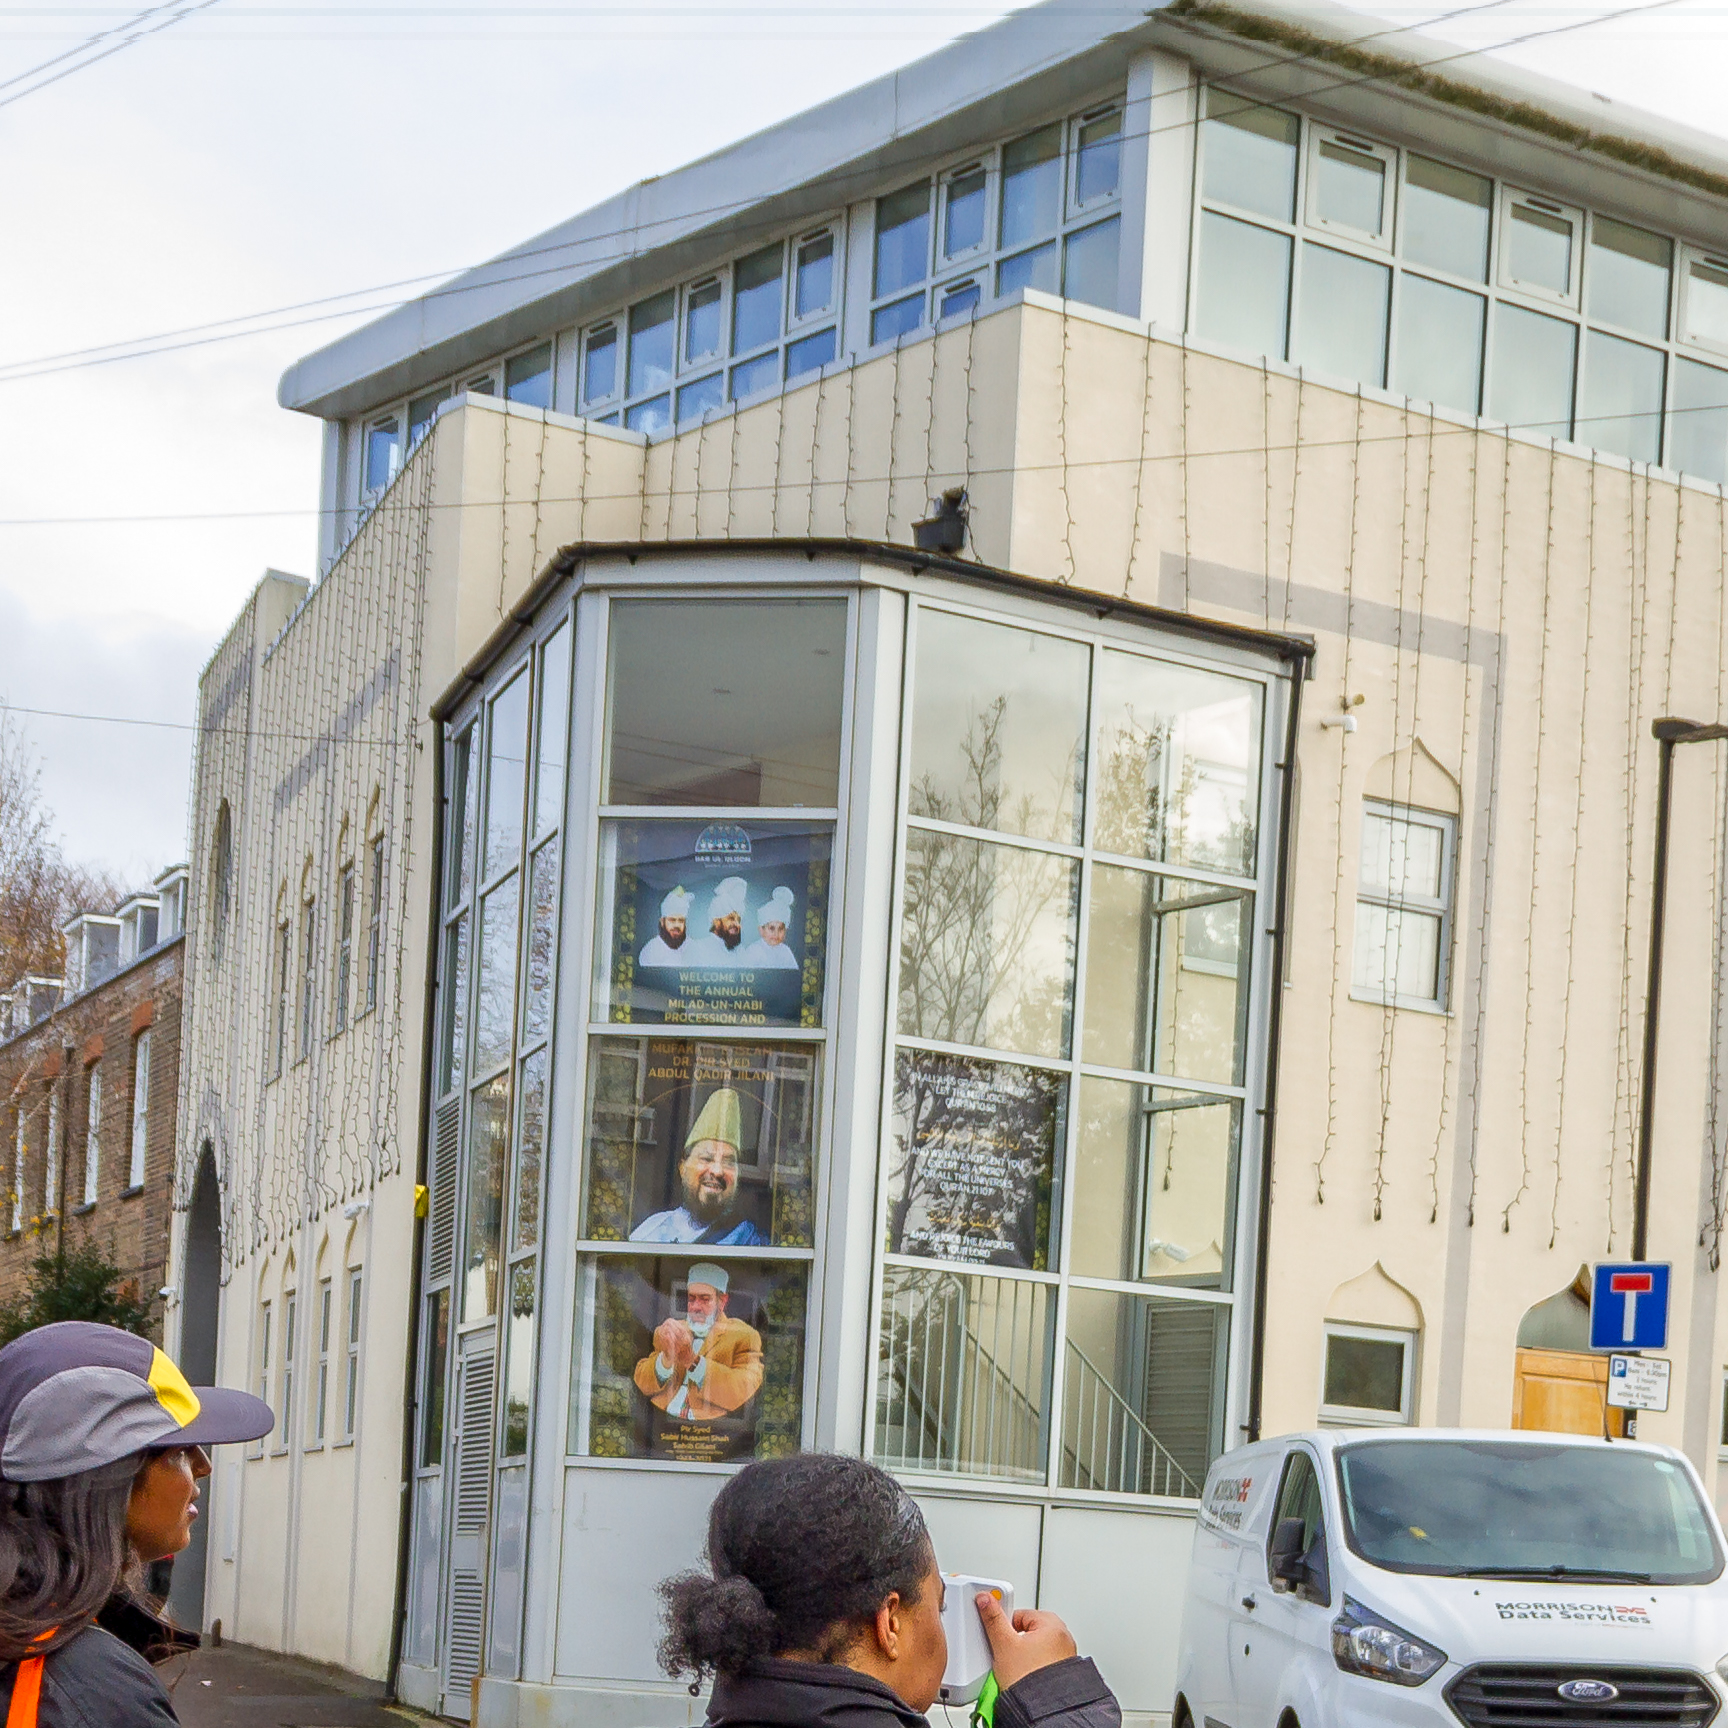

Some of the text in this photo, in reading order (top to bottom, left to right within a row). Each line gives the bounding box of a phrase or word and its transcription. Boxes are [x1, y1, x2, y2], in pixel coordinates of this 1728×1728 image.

[679, 971, 755, 983] WELCOME TO
[679, 985, 754, 997] THE ANNUAL
[668, 999, 763, 1011] MILAD-UN-NABI
[664, 1012, 766, 1024] PROCESSION AND
[648, 1067, 774, 1081] ABDUL QADIR JILANI
[1495, 1601, 1614, 1613] MORRISON
[1498, 1610, 1652, 1625] Data Services
[1571, 1682, 1604, 1698] Ford
